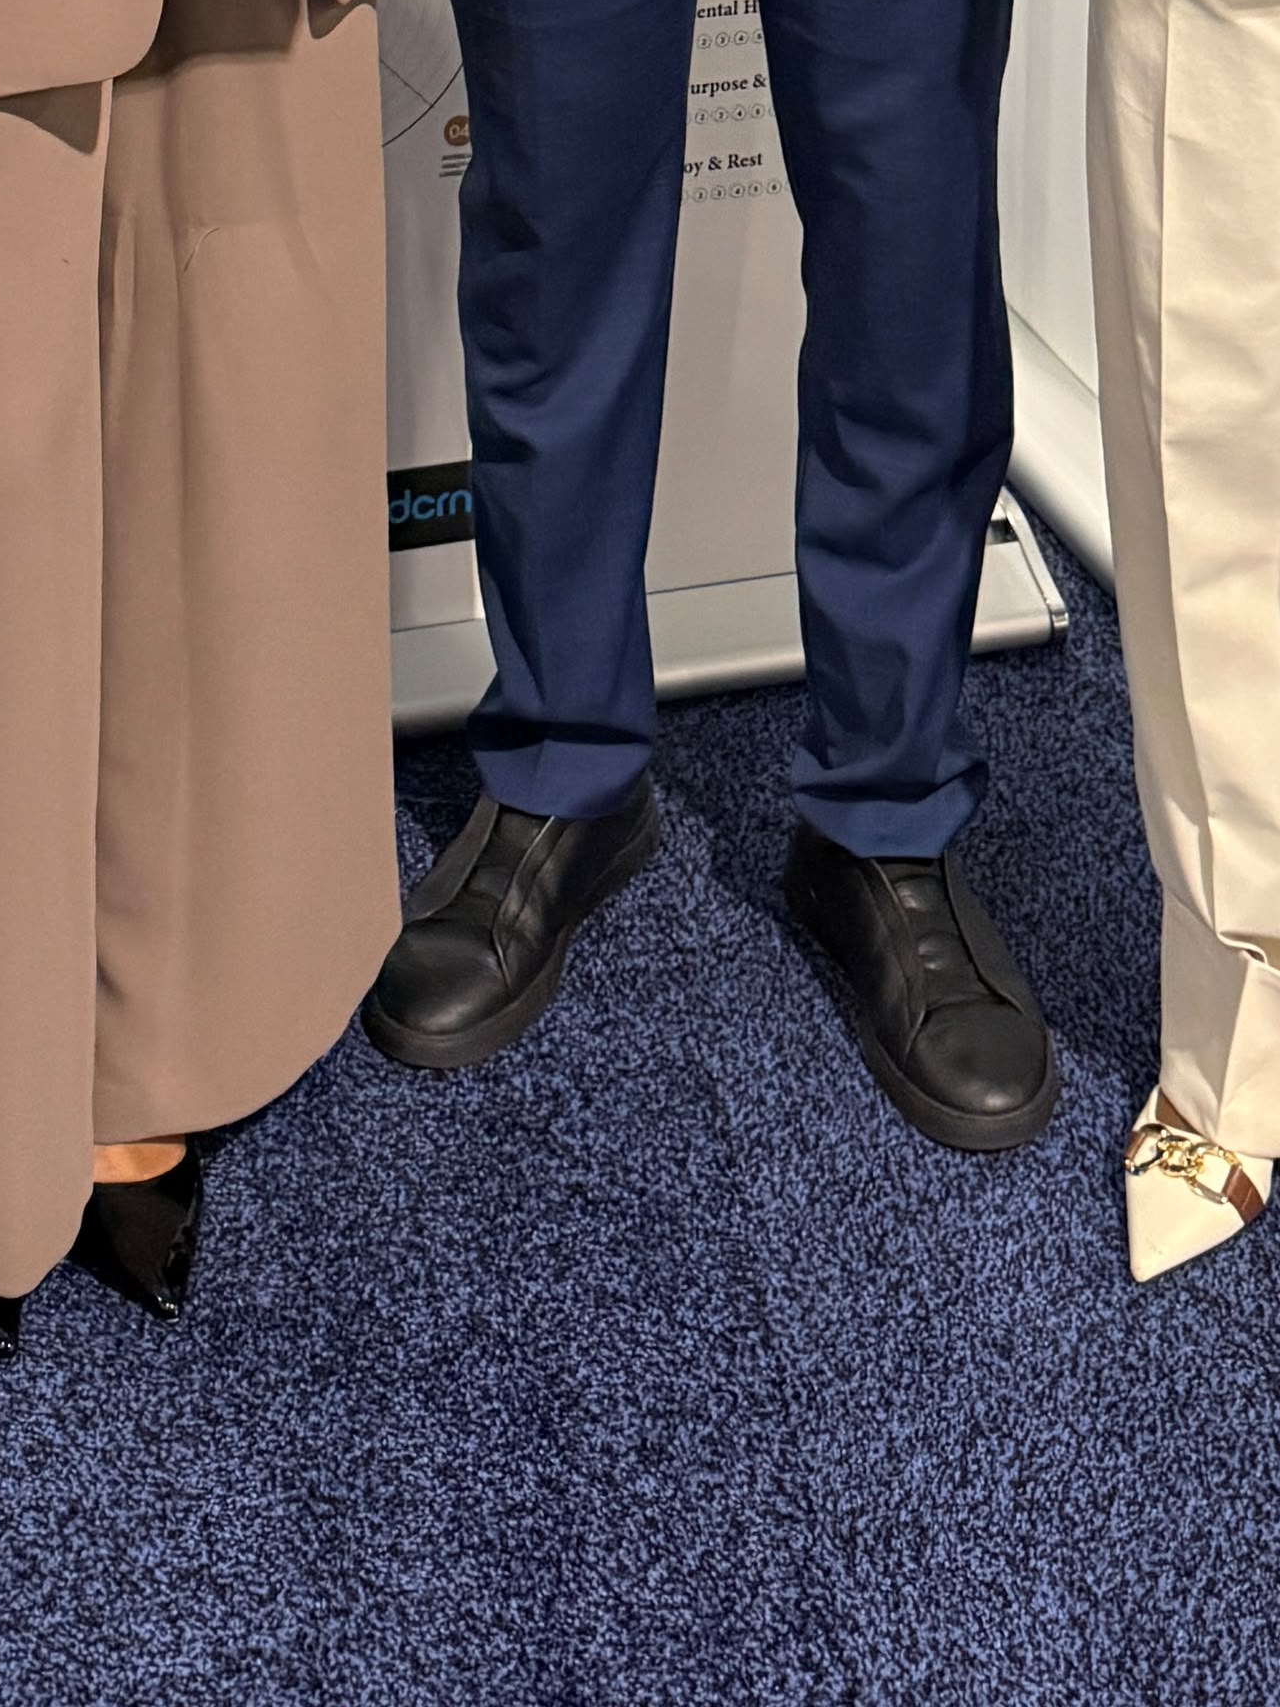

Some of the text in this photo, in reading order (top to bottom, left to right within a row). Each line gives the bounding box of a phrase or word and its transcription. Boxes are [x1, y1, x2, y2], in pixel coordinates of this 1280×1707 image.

[697, 0, 738, 18] ental
[690, 73, 767, 97] urpose &
[708, 156, 722, 171] &
[727, 153, 763, 169] Rest
